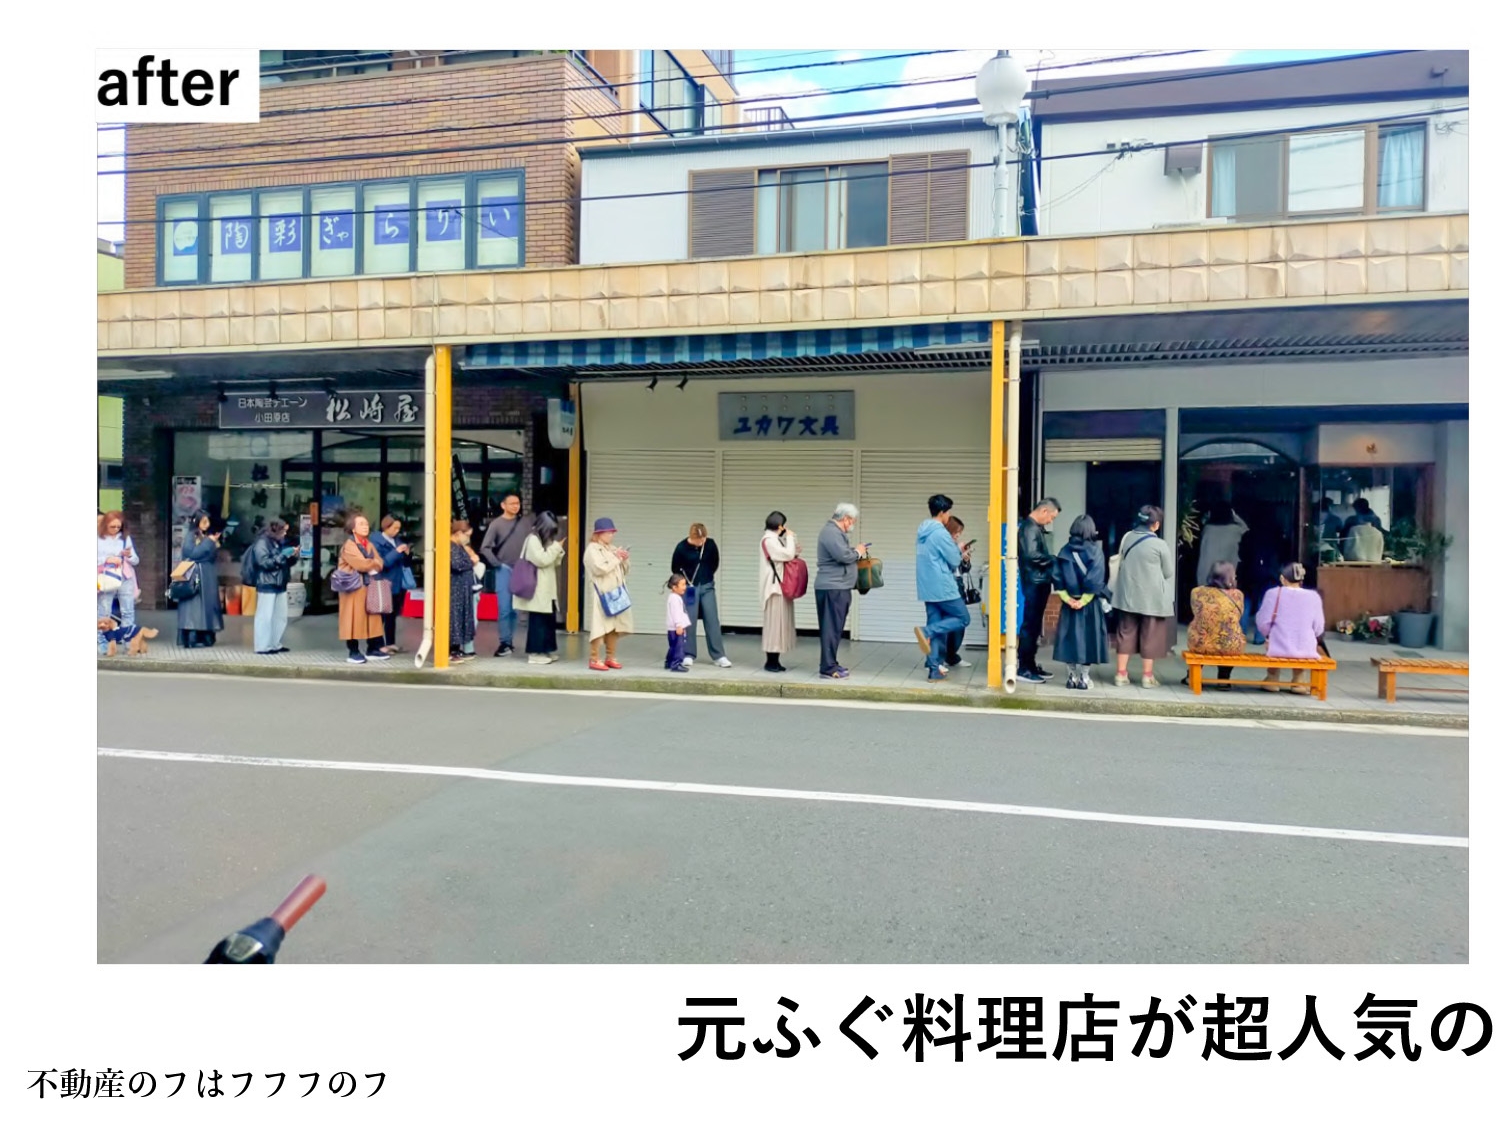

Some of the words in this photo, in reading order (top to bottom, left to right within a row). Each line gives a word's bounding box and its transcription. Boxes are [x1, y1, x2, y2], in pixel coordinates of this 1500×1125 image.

[254, 412, 291, 423] 小田原店
[733, 415, 840, 436] ユカワ文具
